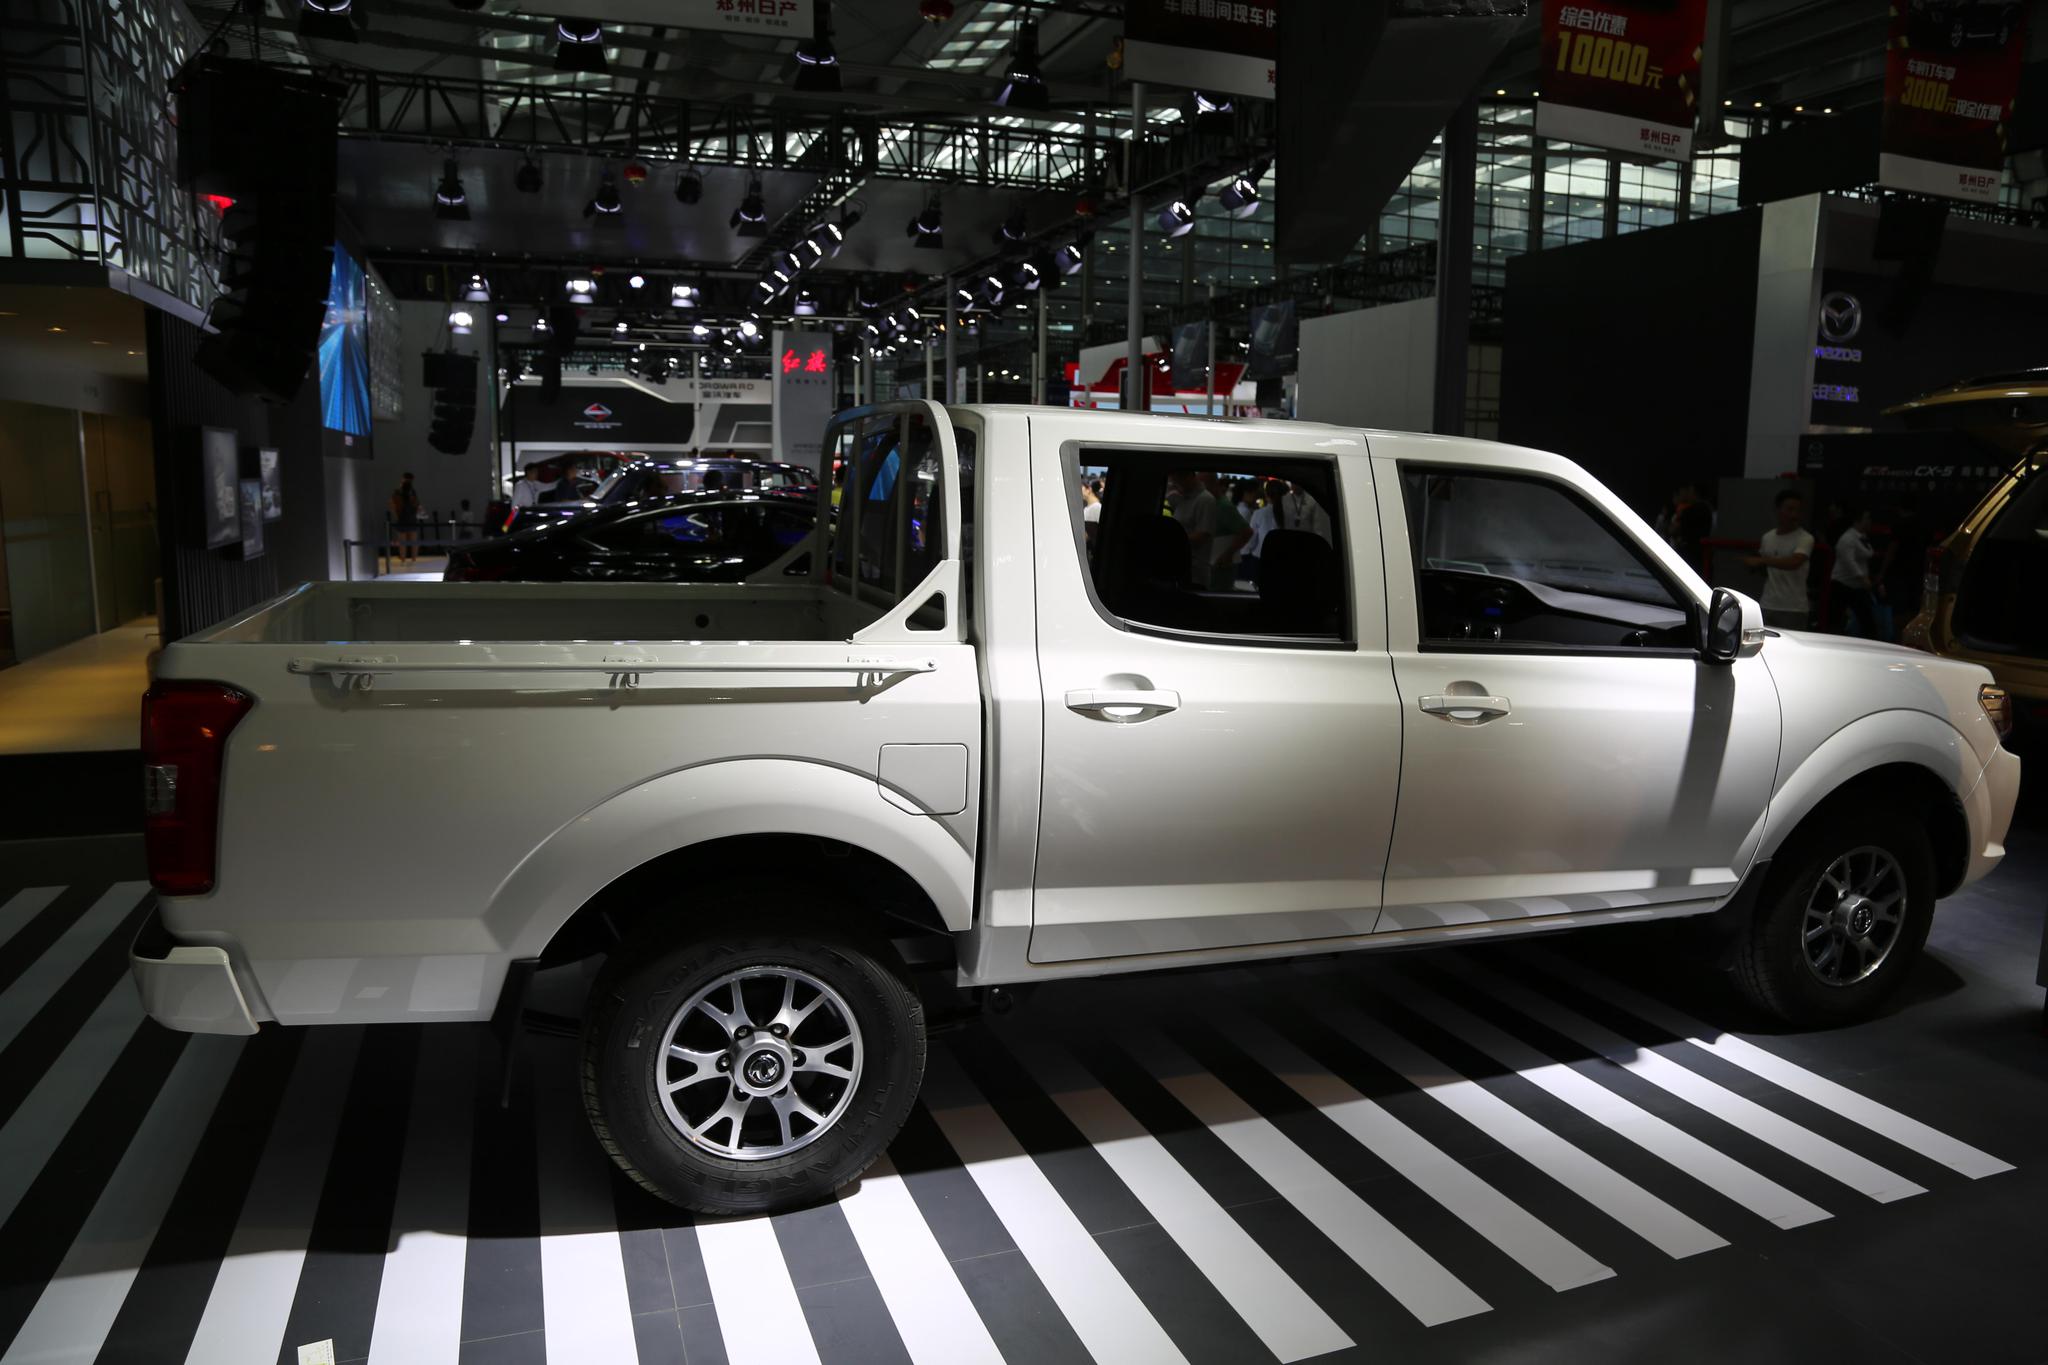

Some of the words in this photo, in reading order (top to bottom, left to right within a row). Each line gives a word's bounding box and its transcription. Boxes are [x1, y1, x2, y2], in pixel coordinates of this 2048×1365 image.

[1558, 5, 1628, 37] 综合优惠
[1556, 31, 1664, 90] 10000元
